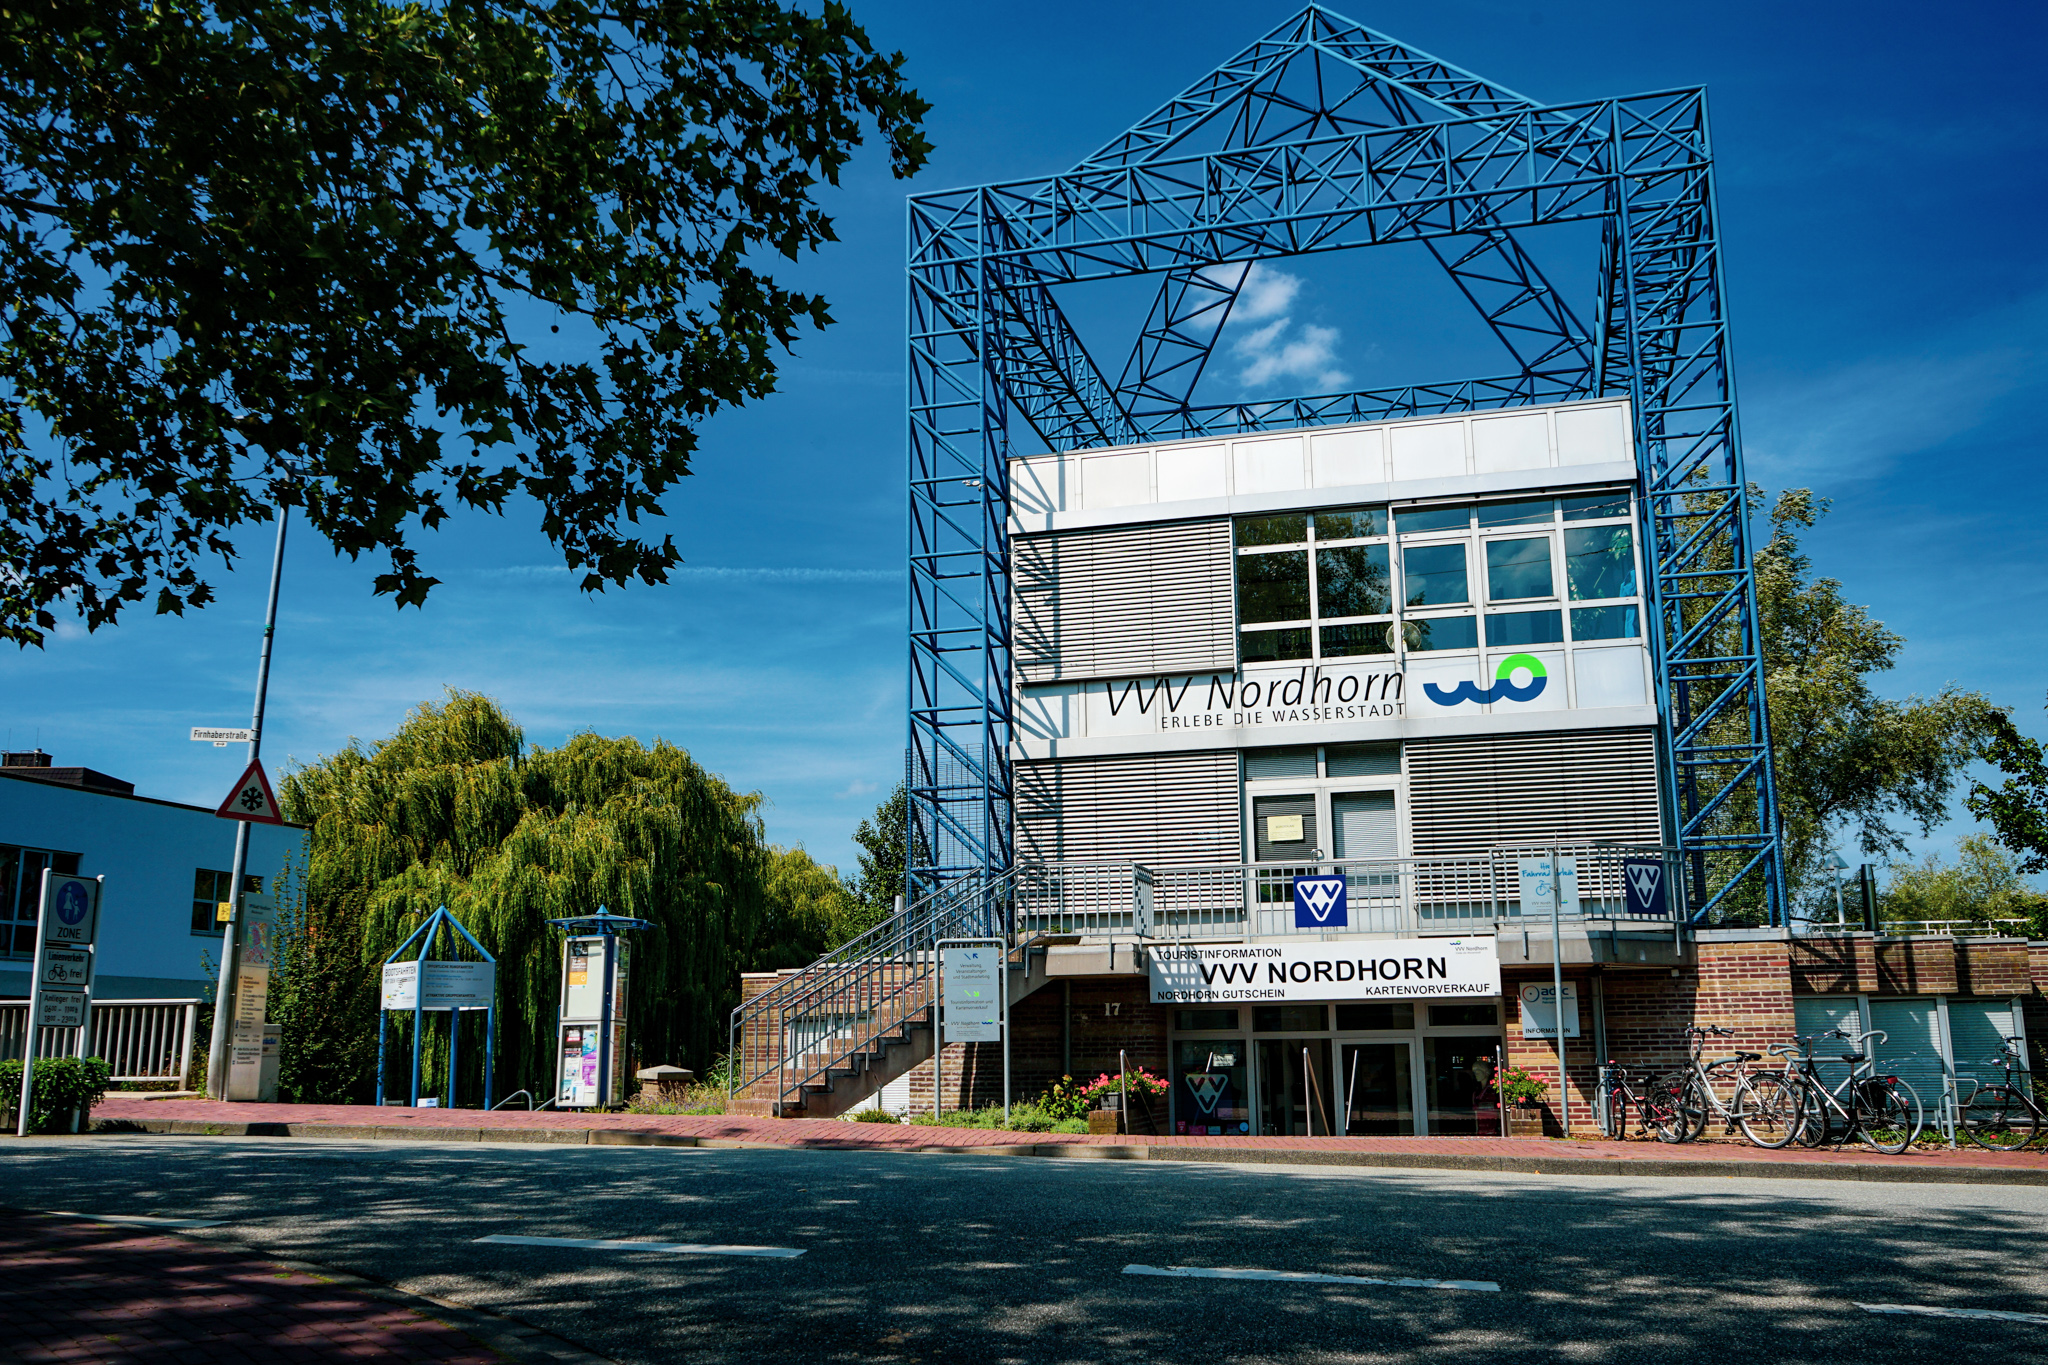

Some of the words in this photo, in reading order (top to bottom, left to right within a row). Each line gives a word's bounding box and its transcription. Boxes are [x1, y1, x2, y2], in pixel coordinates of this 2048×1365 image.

[1106, 676, 1194, 716] VVV
[1207, 665, 1404, 711] Nordhorn
[1161, 713, 1224, 729] ERLEBE
[1234, 711, 1263, 725] DIE
[1272, 702, 1405, 723] WASSERSTADT
[193, 729, 248, 740] Firnhaberstraße
[56, 926, 82, 939] ZONE
[1158, 948, 1282, 960] TOURISTINFORMATION
[69, 968, 83, 979] frei
[384, 966, 417, 977] BOOTSFAHRTEN
[1199, 962, 1258, 985] VVV
[1268, 957, 1447, 984] NORDHORN
[1157, 990, 1219, 1000] NORDHORN
[1222, 988, 1285, 999] GUTSCHEIN
[1366, 983, 1490, 996] KARTENVORVERKAUF
[1104, 1002, 1121, 1017] 17
